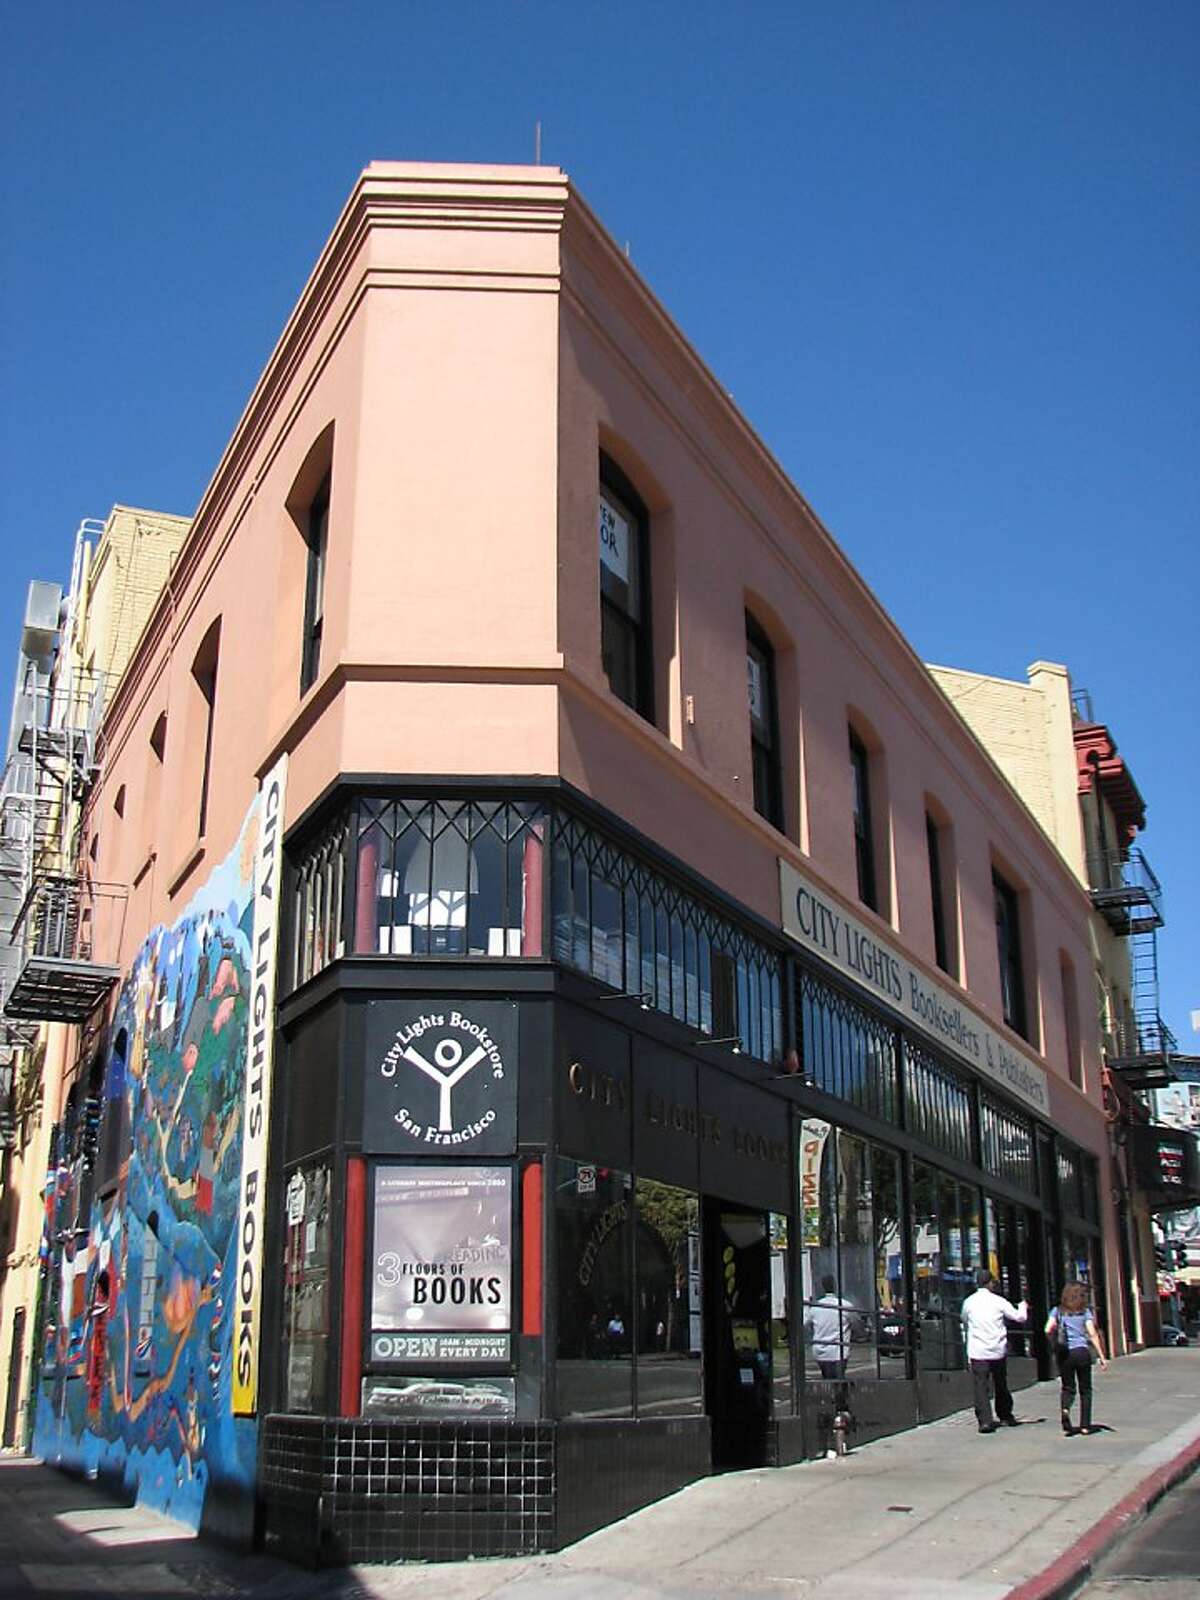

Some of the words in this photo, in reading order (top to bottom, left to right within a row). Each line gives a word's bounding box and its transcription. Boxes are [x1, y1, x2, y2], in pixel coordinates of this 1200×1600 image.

[261, 781, 279, 899] CITY
[796, 887, 840, 957] CITY
[844, 922, 902, 1001] LIGHTS
[909, 971, 979, 1057] Booksellers
[250, 926, 271, 1138] LIGHTS
[381, 1042, 404, 1078] City
[397, 1014, 444, 1045] Lights
[450, 1011, 504, 1079] Bookstore
[394, 1108, 421, 1138] San
[424, 1109, 496, 1145] Francisco
[238, 1169, 258, 1387] BOOKS
[377, 1252, 400, 1286] 3
[402, 1263, 445, 1275] FLOORS
[450, 1262, 465, 1275] OF
[413, 1277, 501, 1304] BOOKS
[374, 1337, 437, 1357] OPEN
[439, 1347, 477, 1358] EVERY
[480, 1347, 506, 1358] DAY
